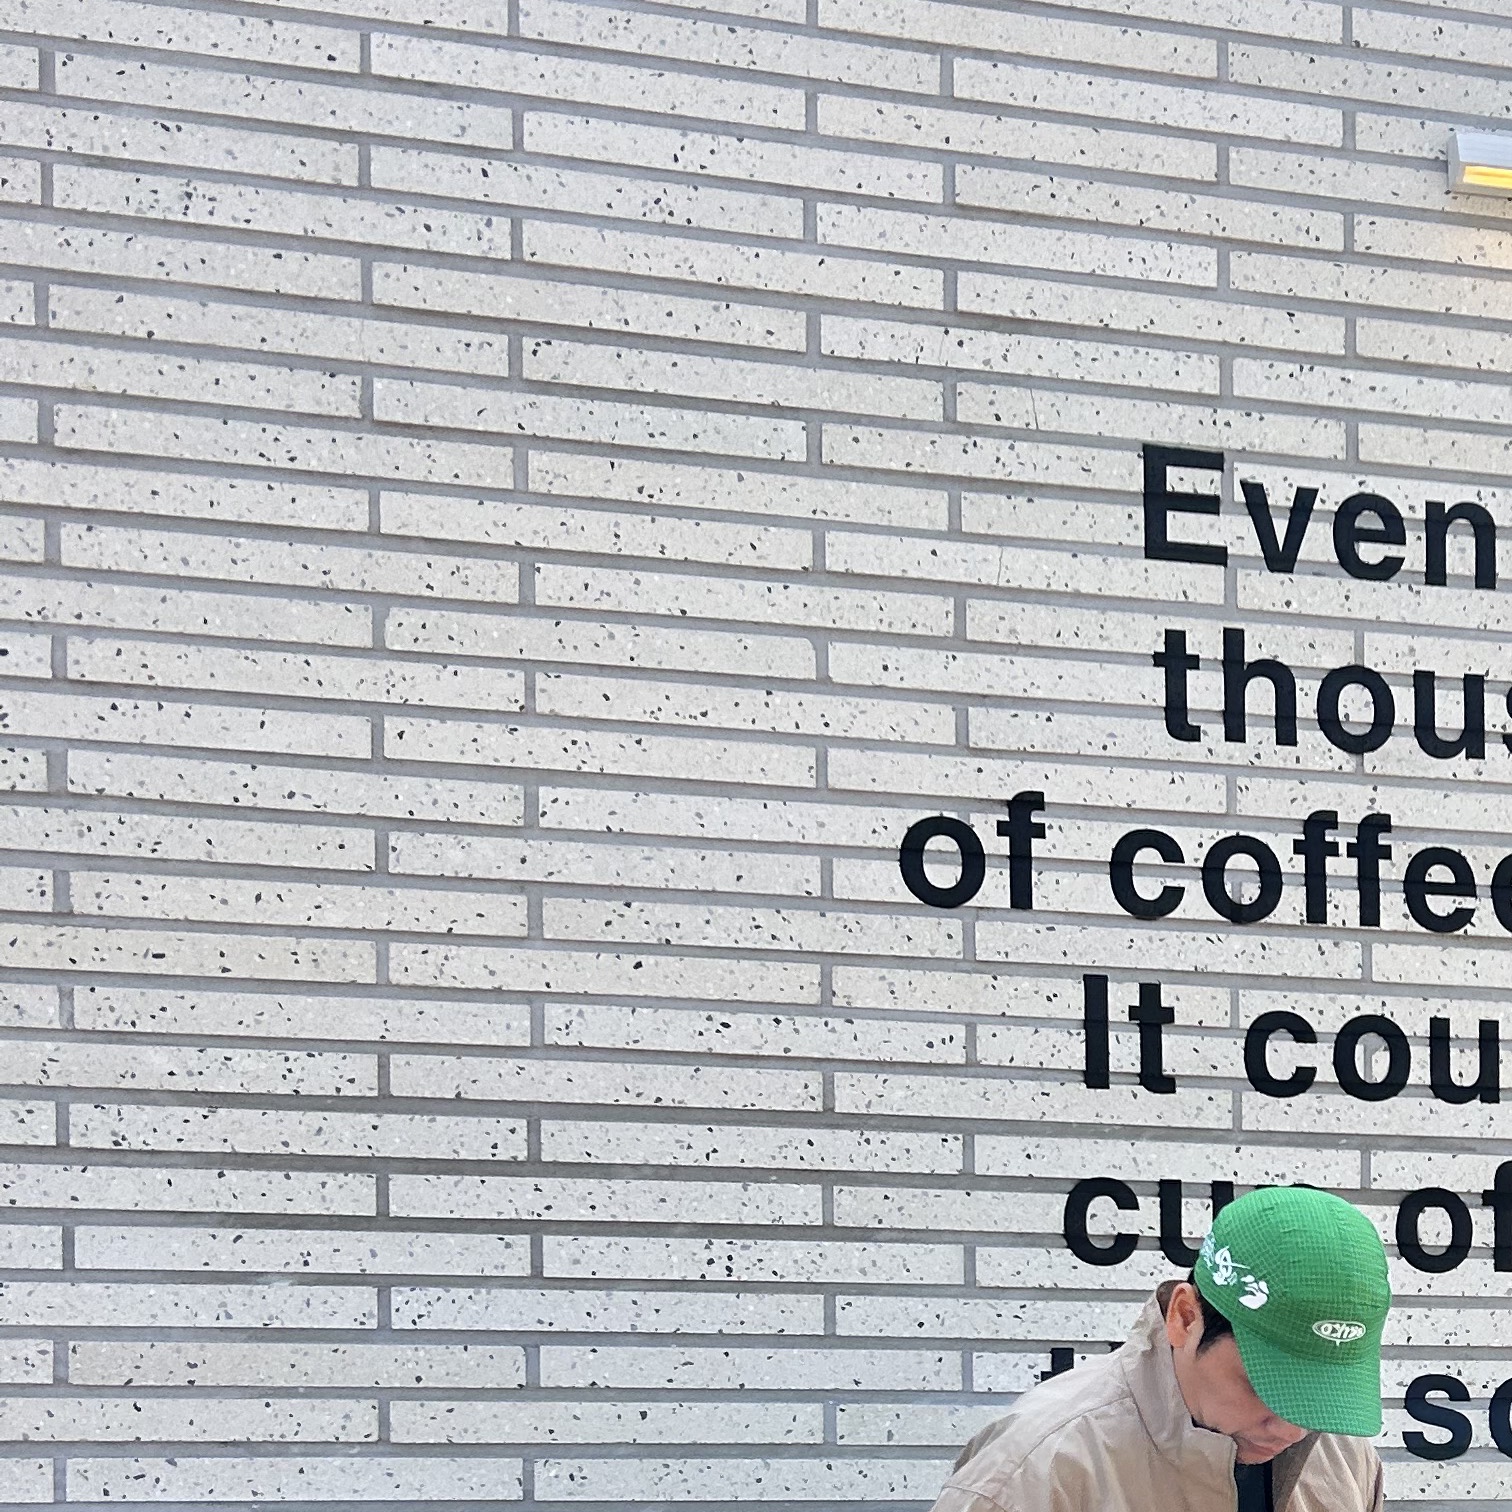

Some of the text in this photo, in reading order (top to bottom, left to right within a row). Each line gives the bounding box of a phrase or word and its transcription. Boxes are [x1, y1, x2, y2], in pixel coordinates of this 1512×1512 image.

[1142, 443, 1498, 590] Even
[897, 791, 1047, 911] of
[1079, 974, 1177, 1095] It
[1057, 1176, 1236, 1268] cu
